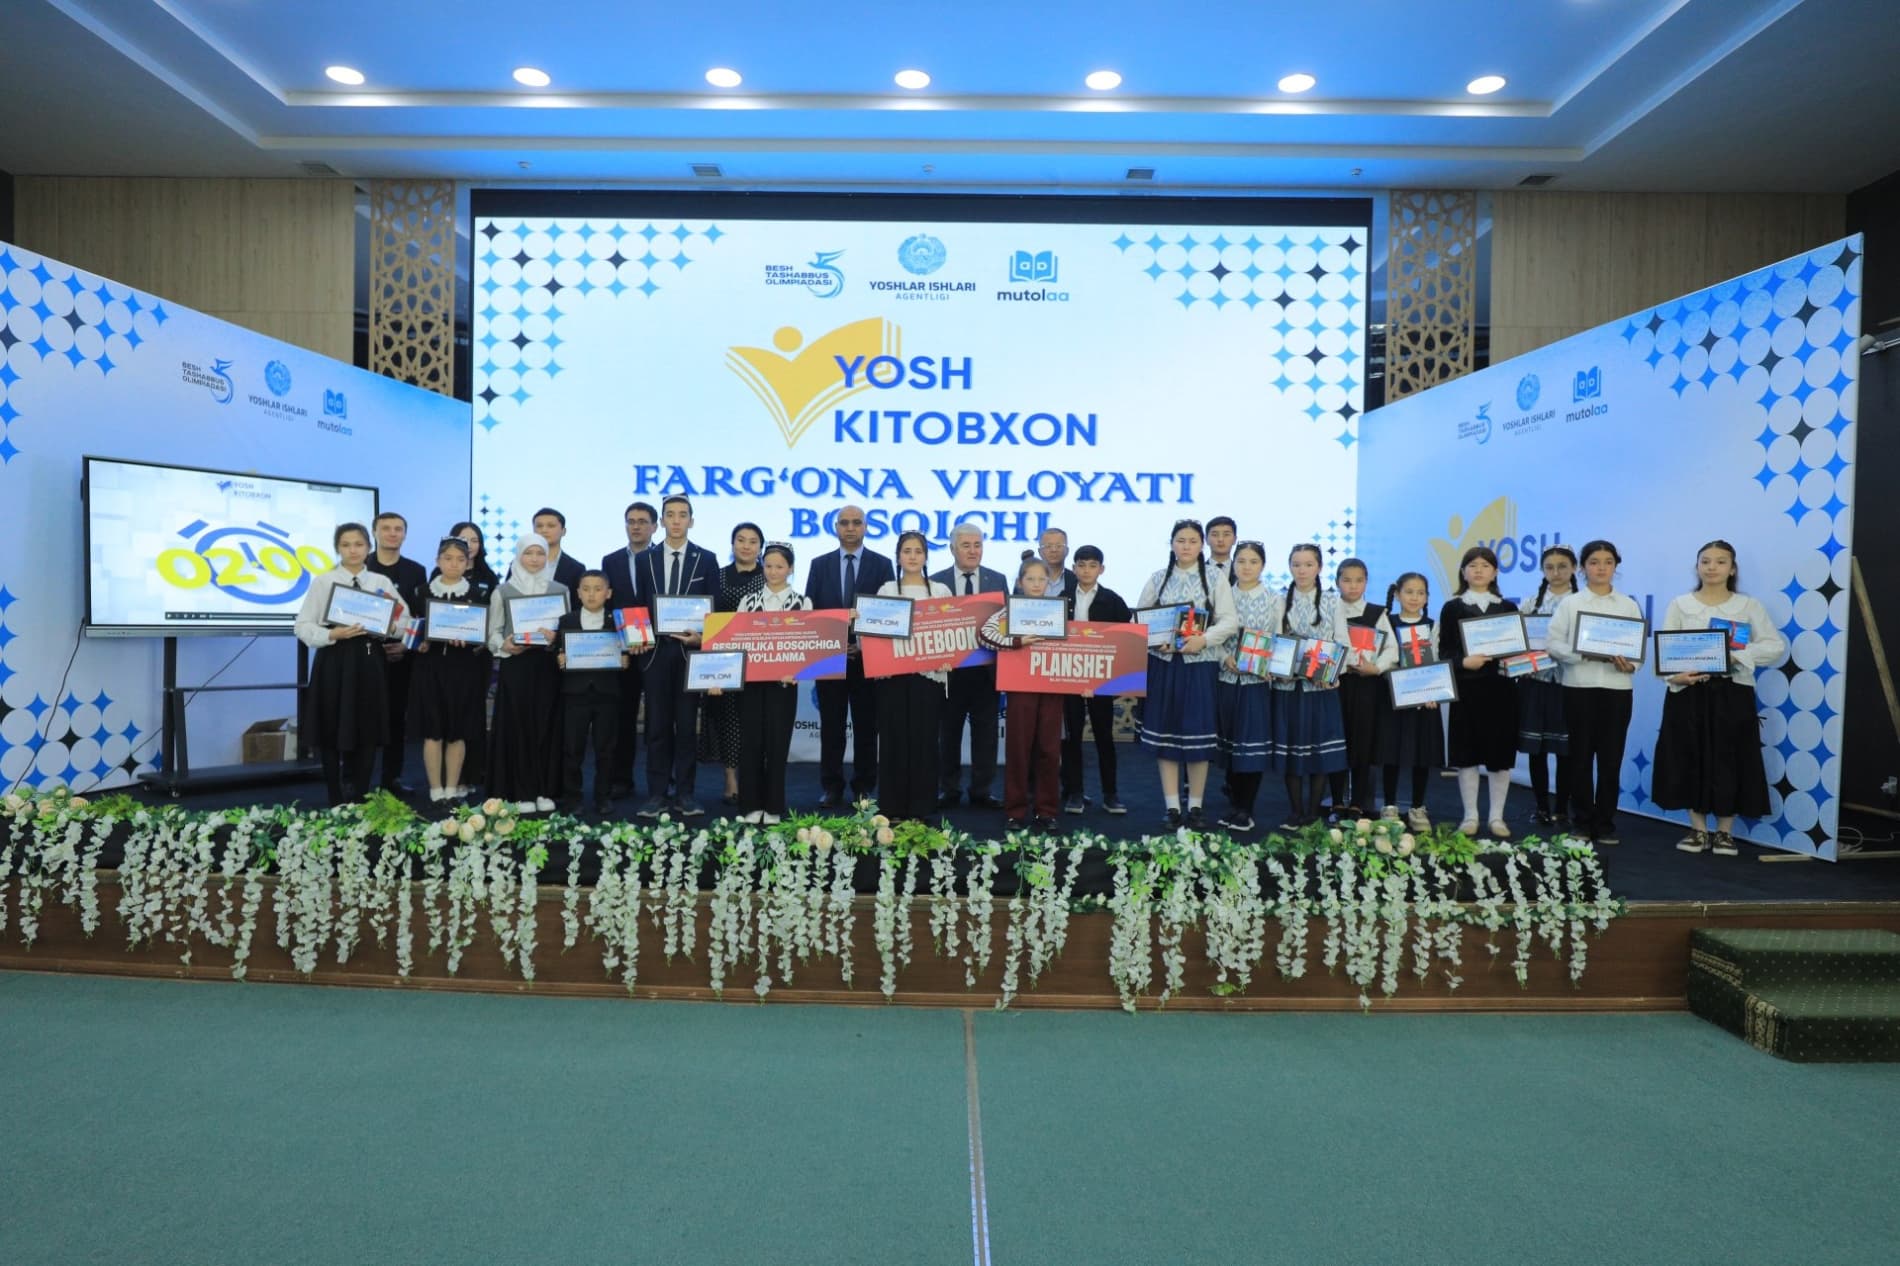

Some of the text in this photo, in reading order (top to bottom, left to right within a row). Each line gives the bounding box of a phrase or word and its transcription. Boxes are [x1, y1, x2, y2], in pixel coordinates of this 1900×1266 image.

[765, 265, 793, 273] BESH
[765, 272, 829, 280] TASHABBUS
[869, 281, 976, 292] YOSHLAR ISHLARI
[895, 293, 950, 301] AGENTLIGI
[996, 289, 1070, 302] mutolaa
[834, 356, 973, 389] YOSH
[248, 395, 308, 417] YOSHLAR ISHLARI
[1566, 403, 1608, 423] mutolaa
[834, 410, 1098, 446] KITOBXON
[1502, 417, 1530, 431] YOSHLAR
[1530, 408, 1556, 424] ISHLARI
[931, 470, 1195, 503] VILOYATI
[1477, 532, 1561, 574] OS
[776, 639, 841, 651] BOSQICHIGA
[893, 626, 979, 658] NOTEBOOK
[1030, 652, 1115, 679] PLANSHET
